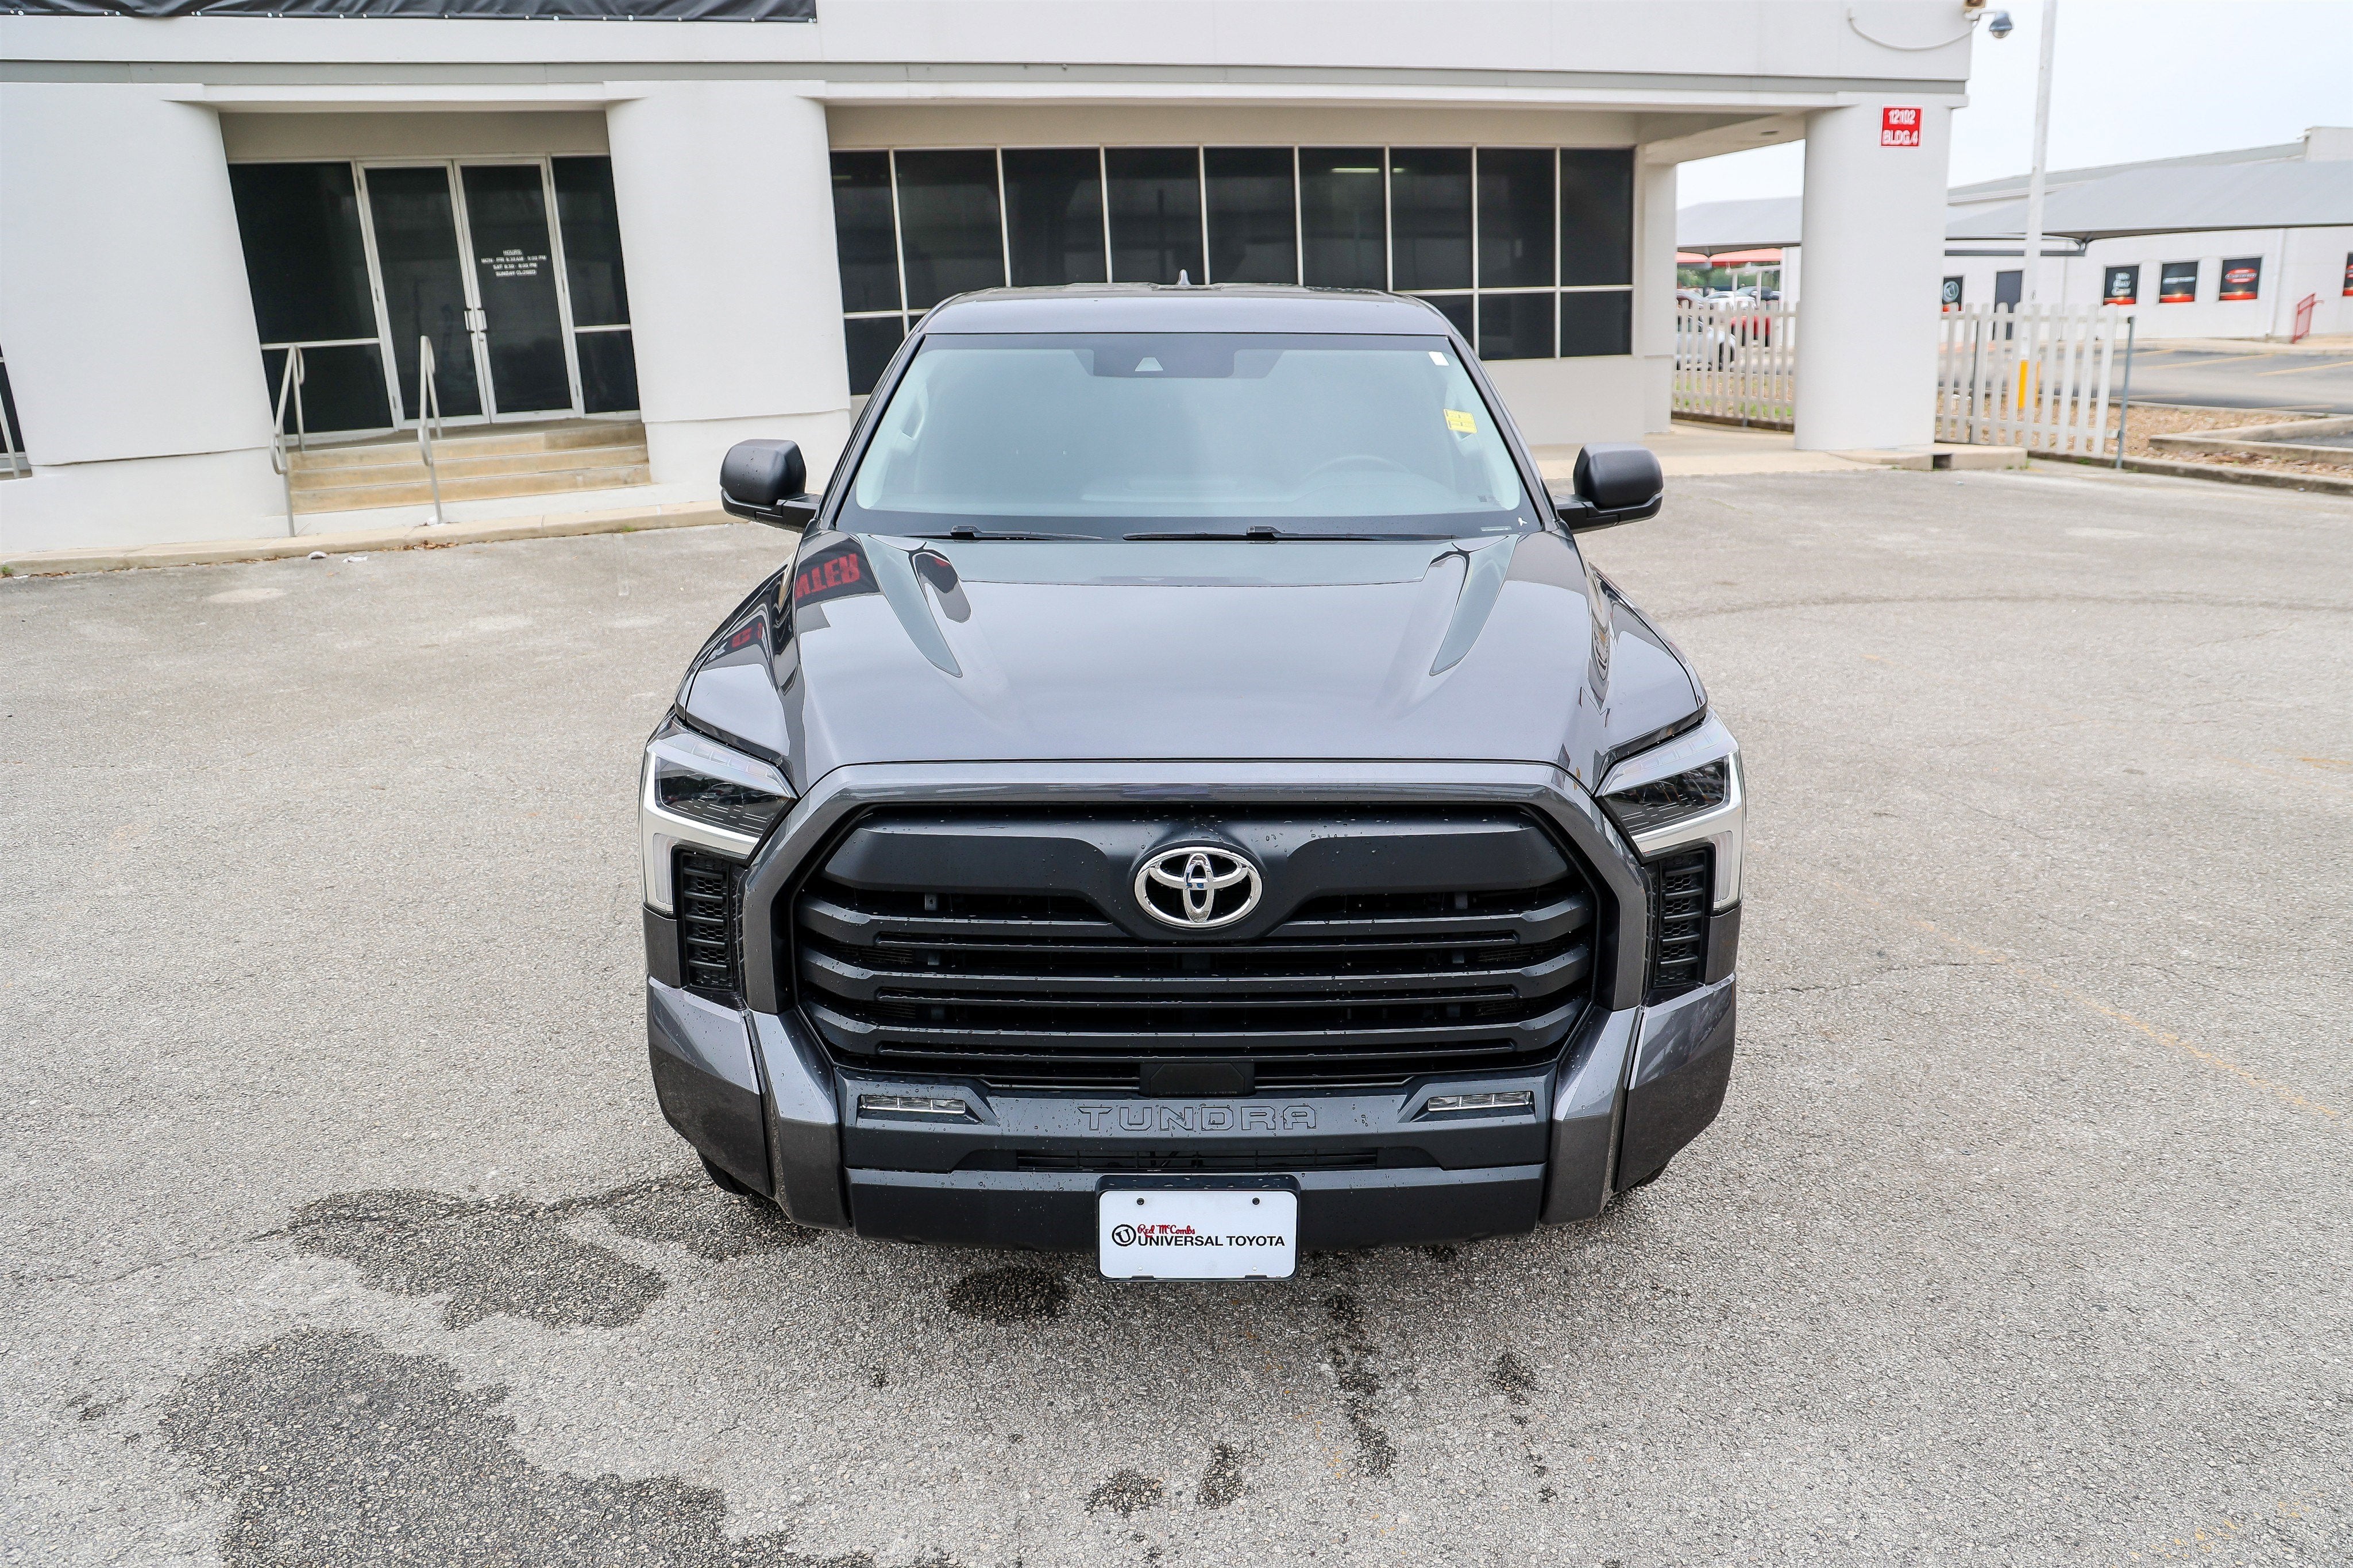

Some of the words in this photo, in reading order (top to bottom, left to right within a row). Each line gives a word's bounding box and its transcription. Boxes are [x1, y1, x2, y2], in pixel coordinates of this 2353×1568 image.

[1888, 109, 1915, 125] 12102
[1077, 1105, 1317, 1131] TUNDRA
[1137, 1224, 1155, 1238] Red
[1156, 1224, 1195, 1235] McCombs
[1138, 1235, 1223, 1246] UNIVERSAL
[1226, 1235, 1285, 1246] TOYOTA
